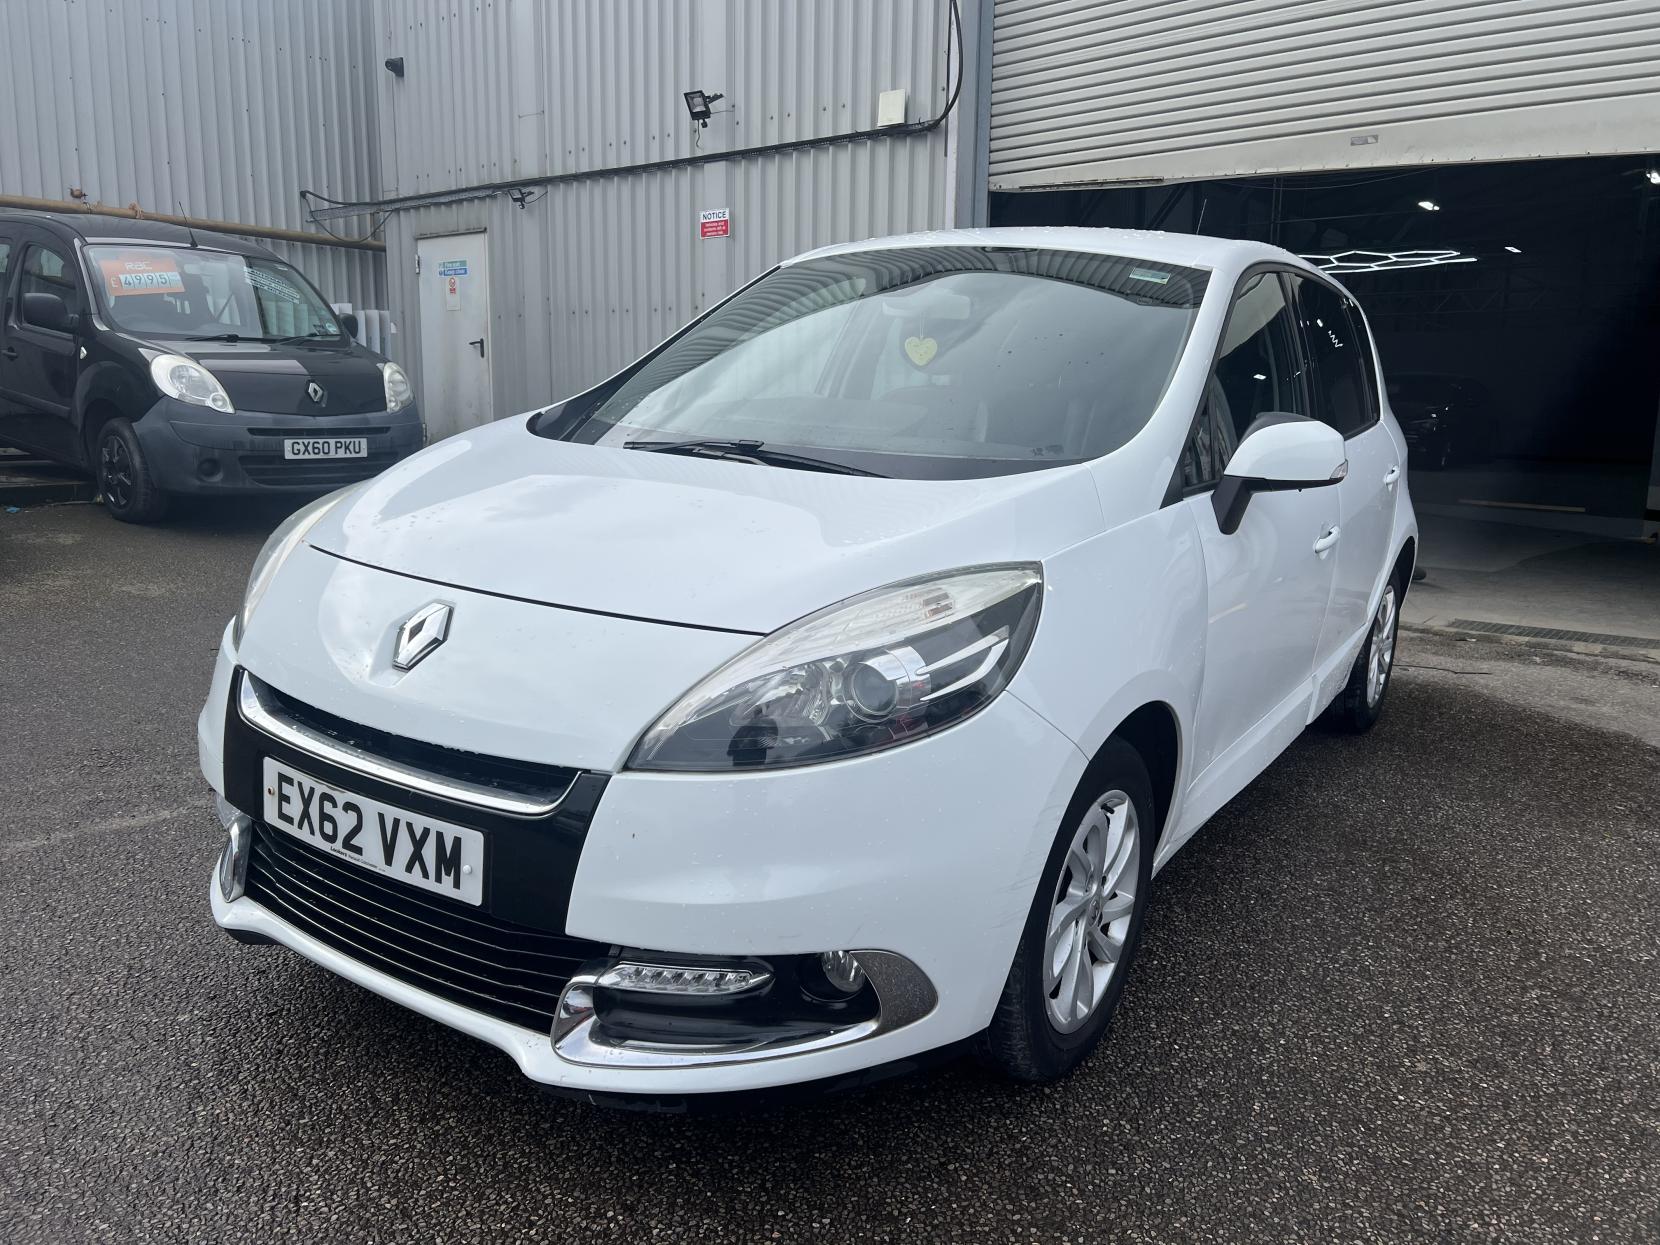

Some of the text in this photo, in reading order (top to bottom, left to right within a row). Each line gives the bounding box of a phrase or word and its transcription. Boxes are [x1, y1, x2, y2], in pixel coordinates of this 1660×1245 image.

[702, 210, 727, 220] NOTICE
[291, 440, 361, 455] GX60 PKU
[277, 771, 462, 890] EX62 VXM
